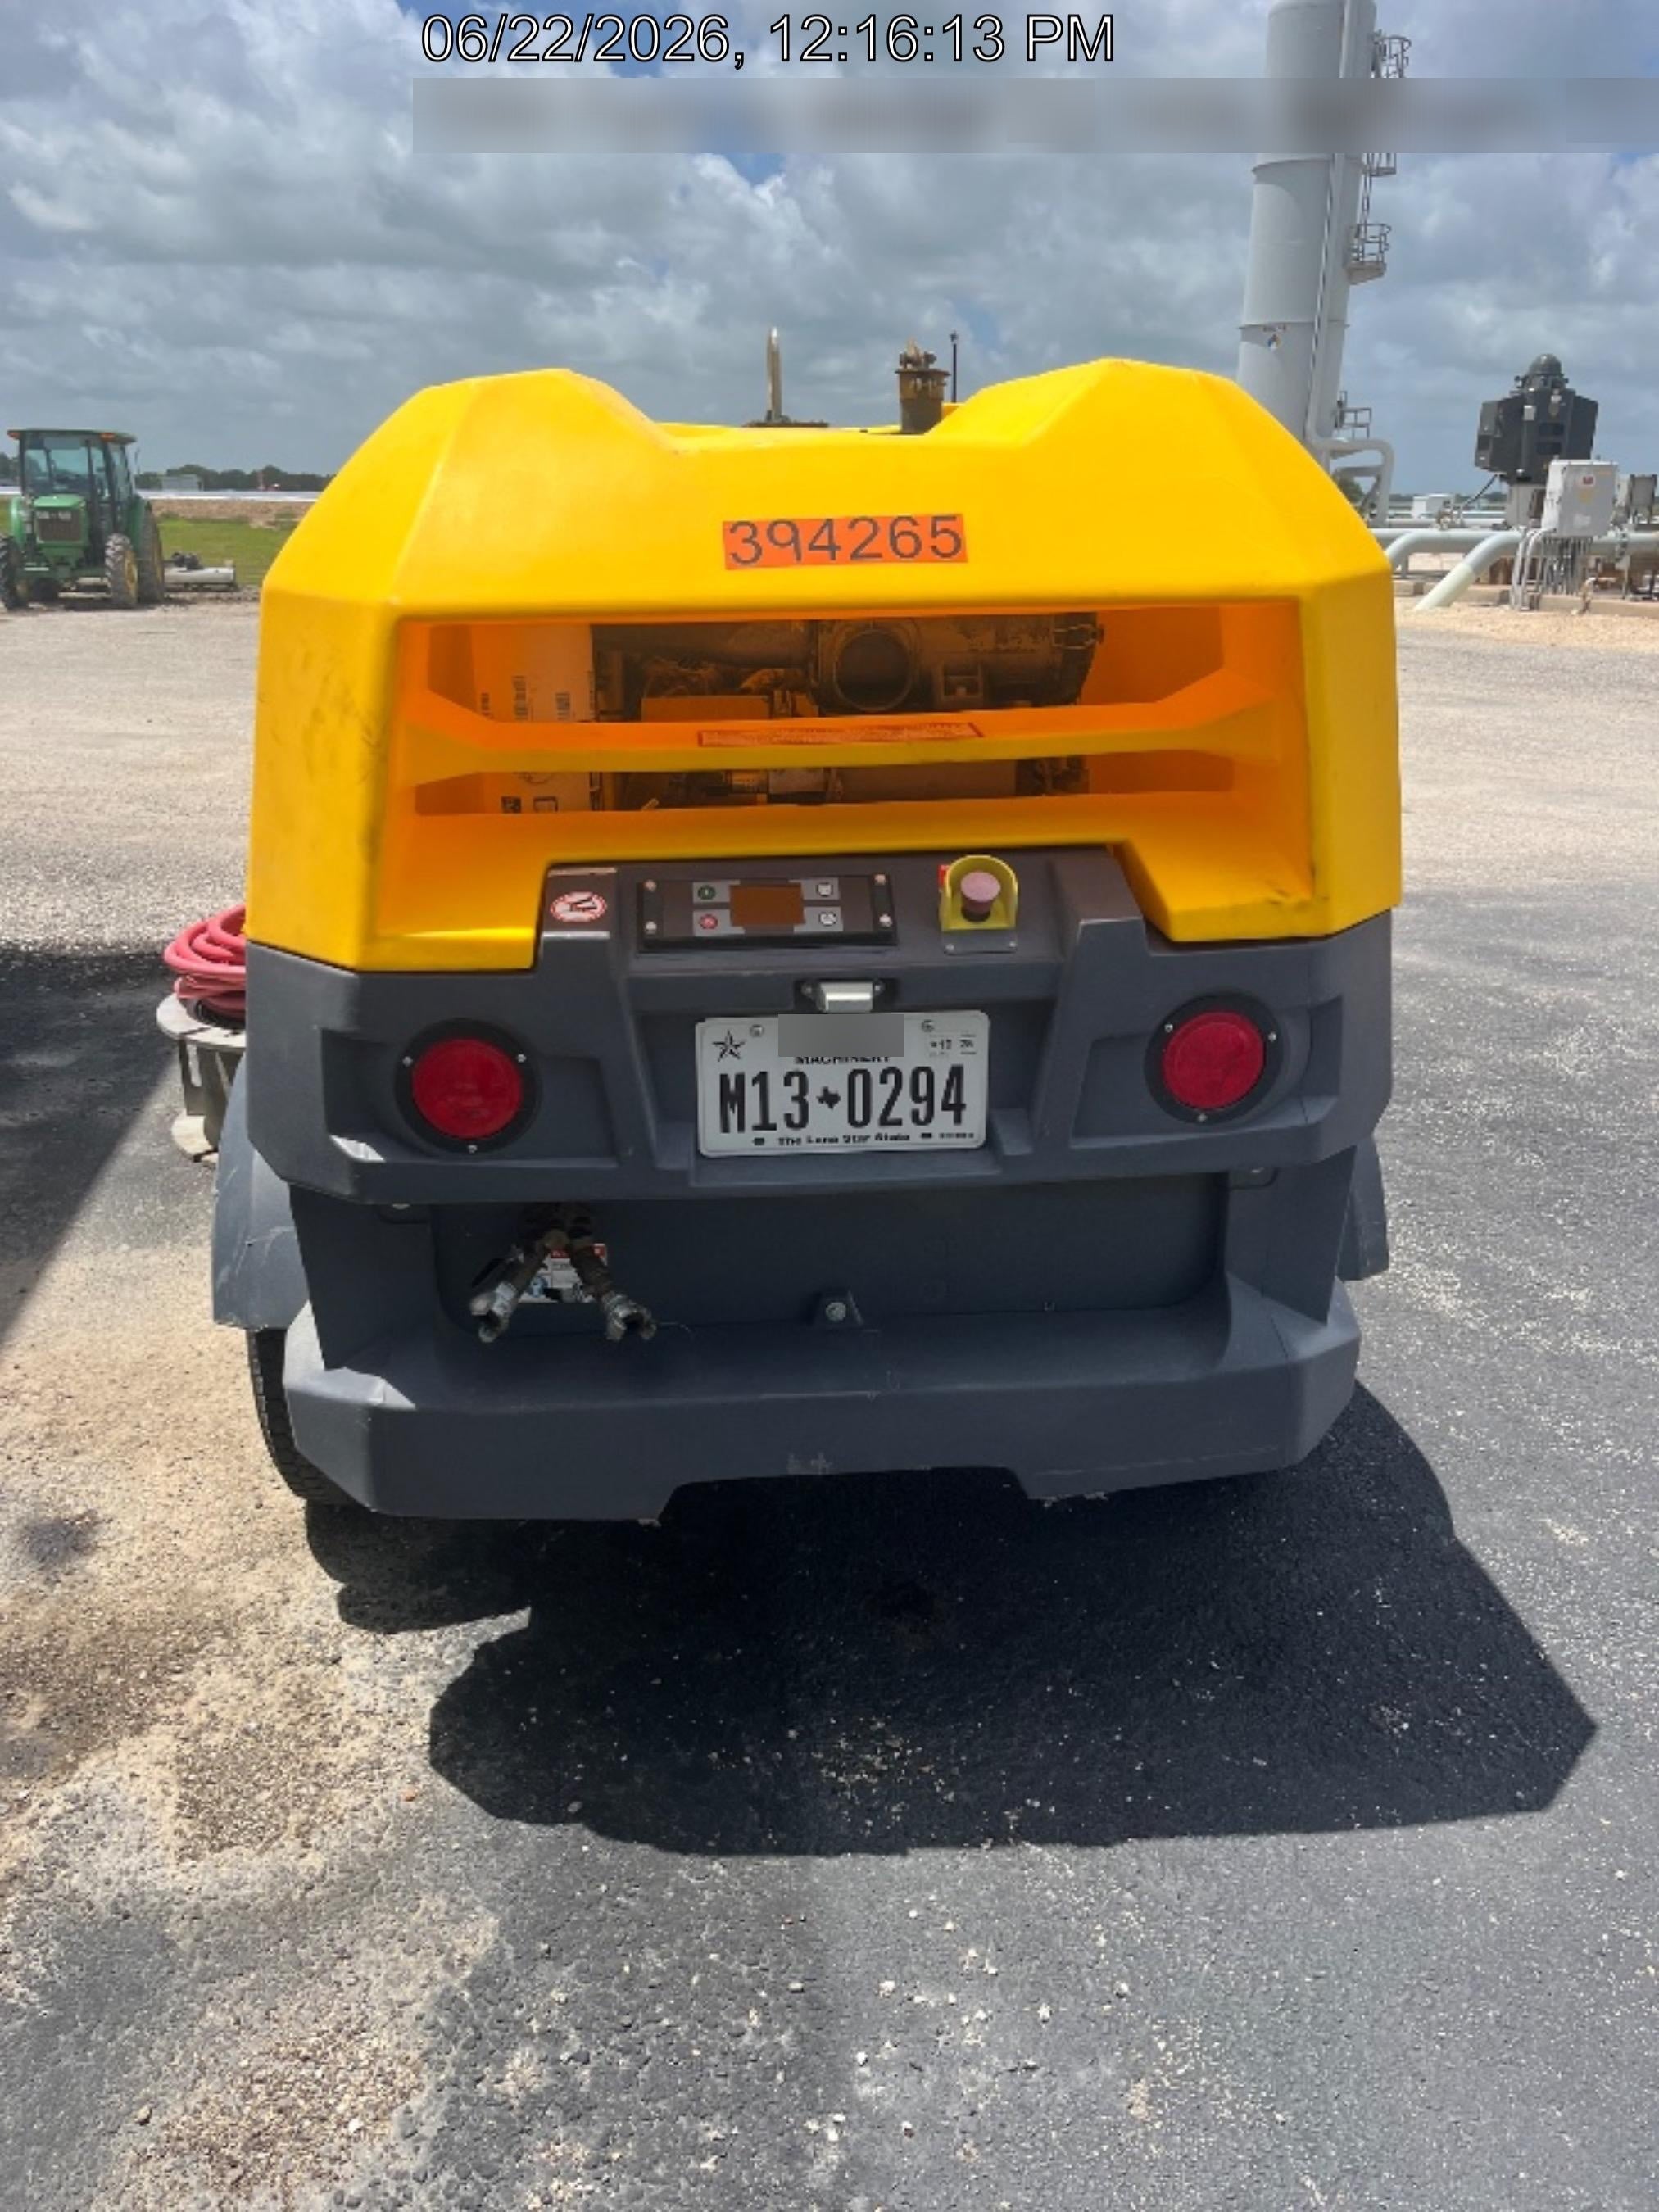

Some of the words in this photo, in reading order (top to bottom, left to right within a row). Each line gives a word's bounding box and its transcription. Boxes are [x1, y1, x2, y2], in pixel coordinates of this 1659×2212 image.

[728, 514, 962, 565] 394265
[719, 1071, 809, 1133] M13
[847, 1064, 967, 1128] 0294
